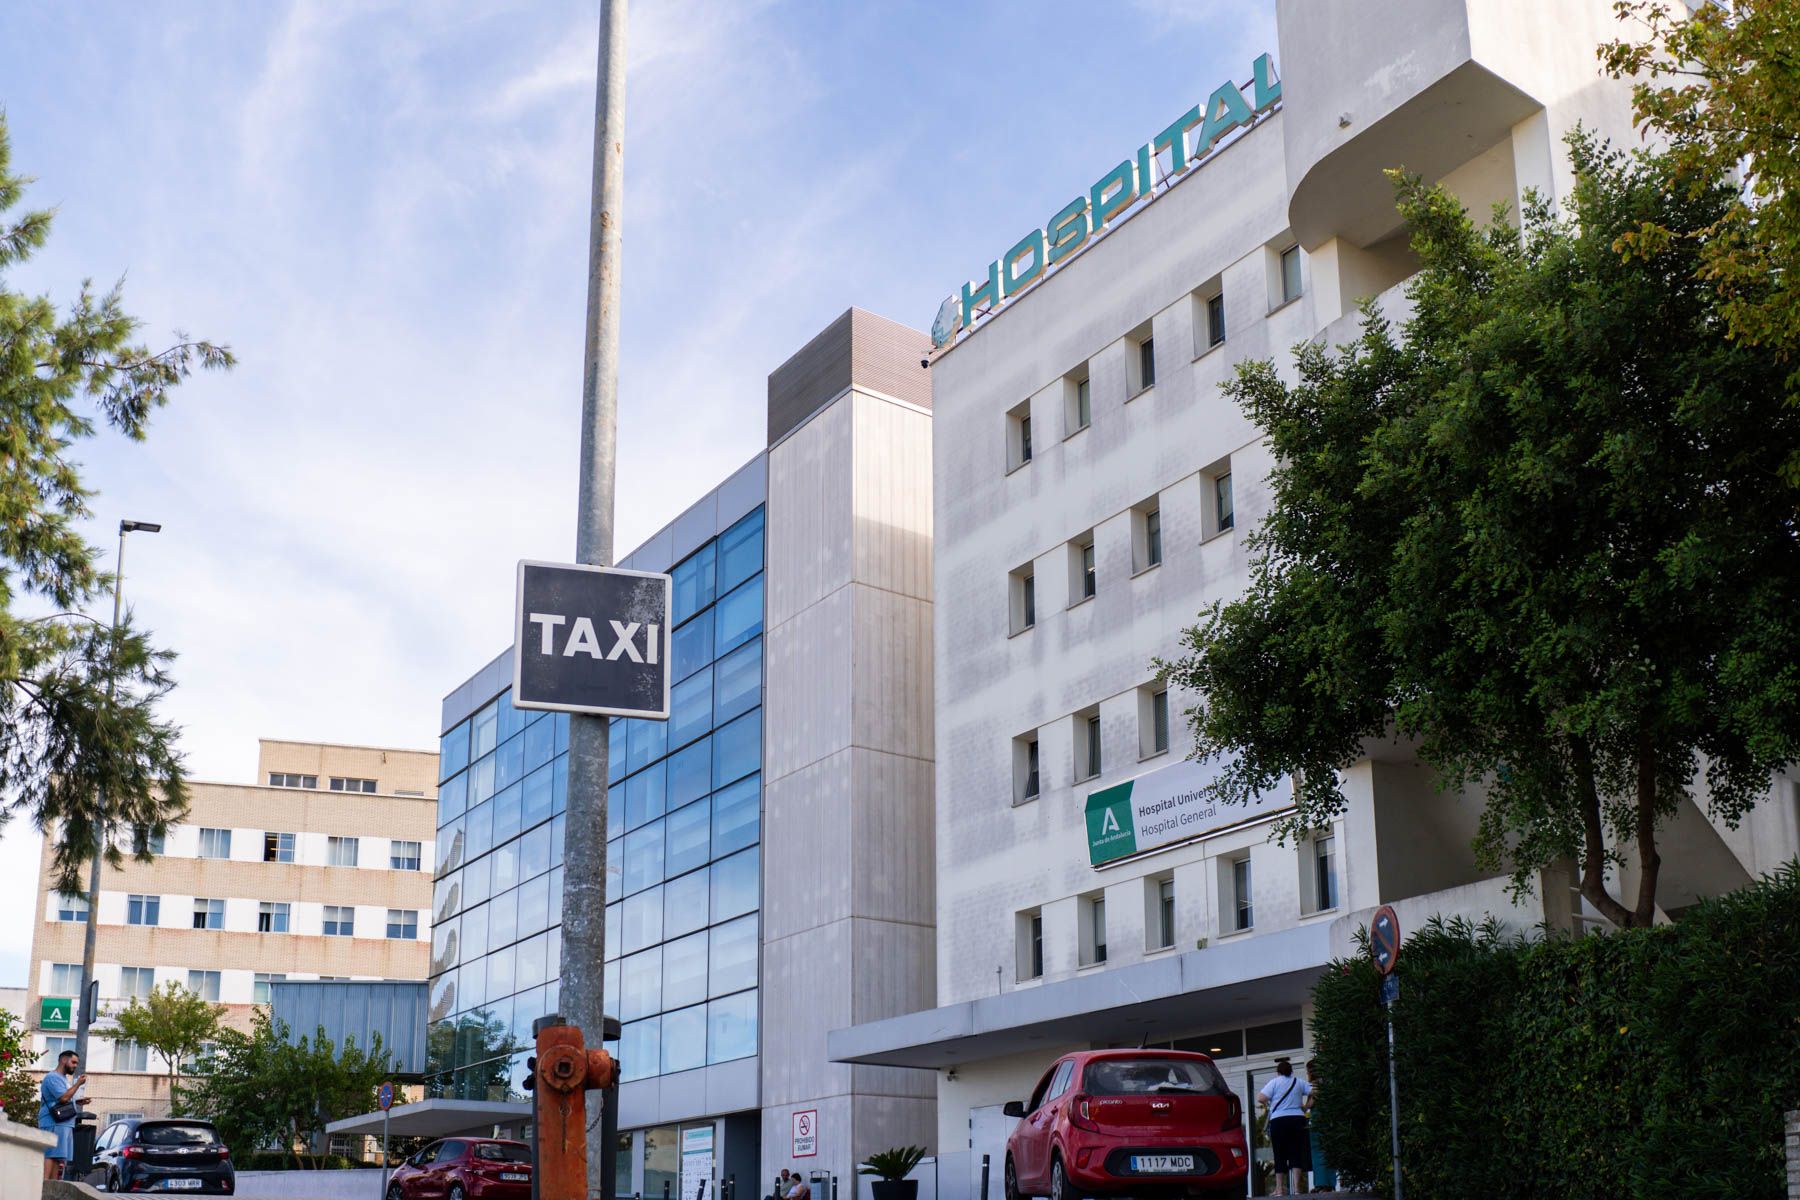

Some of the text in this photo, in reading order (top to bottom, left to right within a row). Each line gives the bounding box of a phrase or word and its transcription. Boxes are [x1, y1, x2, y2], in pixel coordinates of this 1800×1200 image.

[960, 52, 1282, 330] HOSPITAL
[529, 612, 660, 665] TAXI
[1138, 796, 1176, 818] Hospital
[1141, 804, 1217, 837] Hospital General
[1140, 1156, 1191, 1168] 1117 MDC
